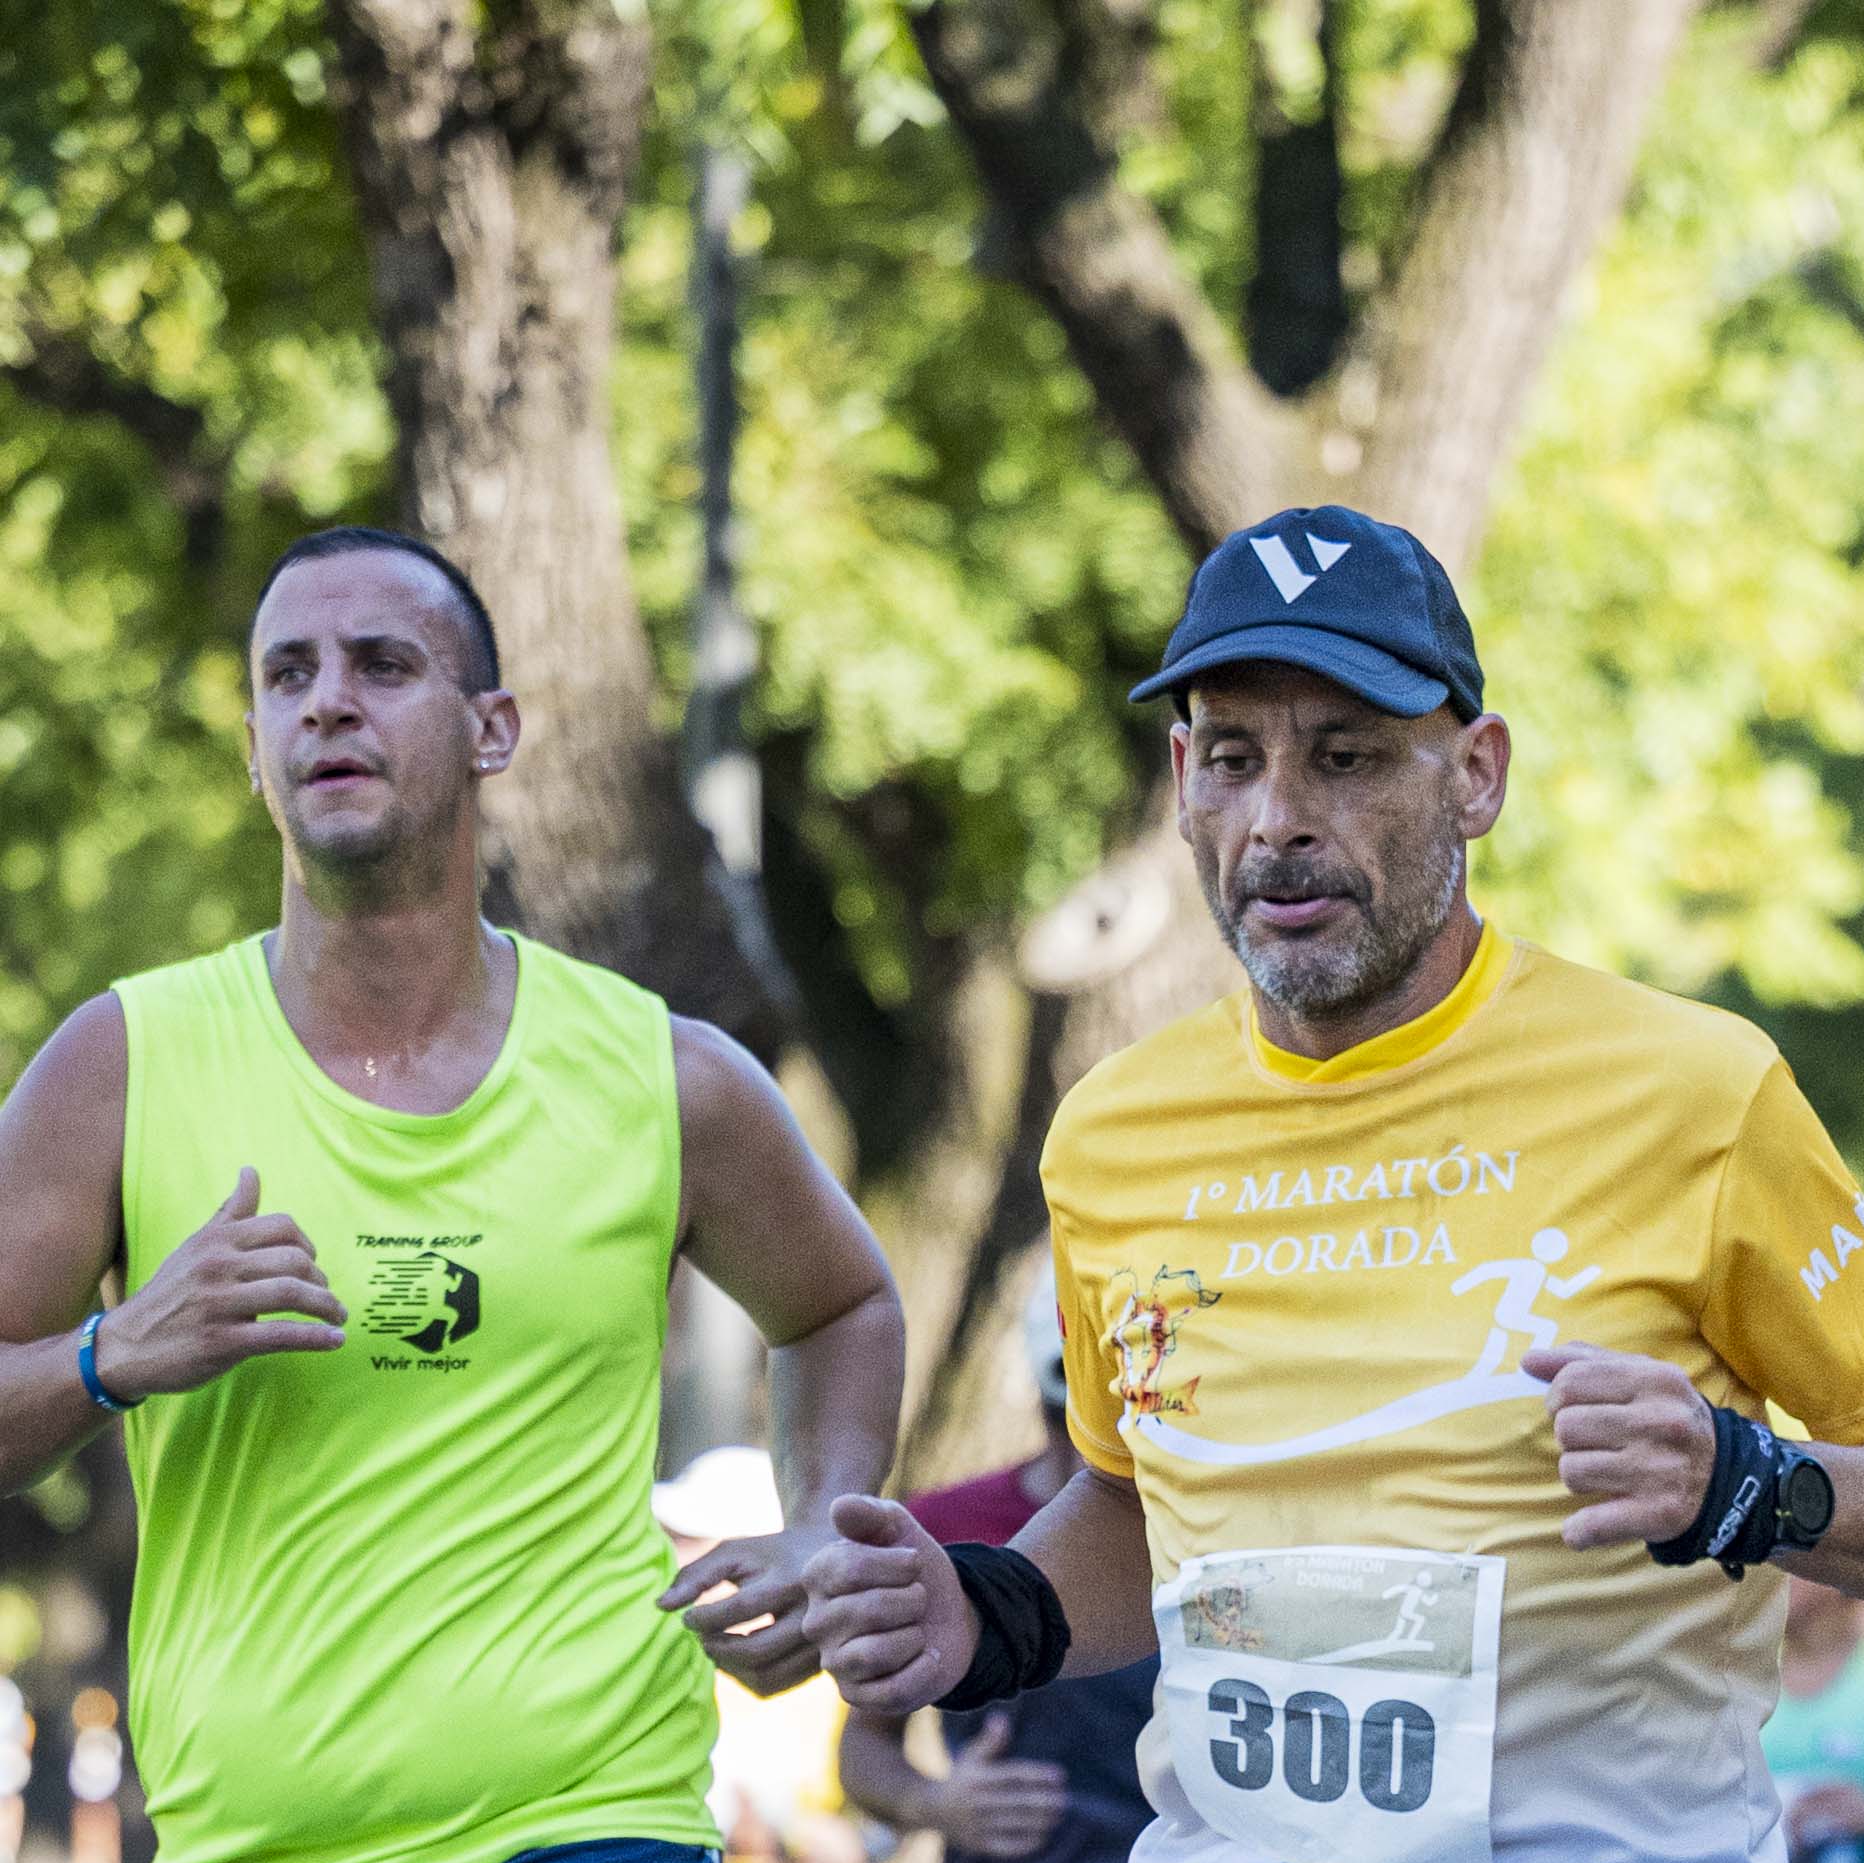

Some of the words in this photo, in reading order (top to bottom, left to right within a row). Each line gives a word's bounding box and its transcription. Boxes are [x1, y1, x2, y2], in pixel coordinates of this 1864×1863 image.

[1232, 1144, 1521, 1215] MARATÓN
[356, 1234, 424, 1248] TRAINING
[429, 1233, 483, 1248] GROUP
[1219, 1222, 1459, 1281] DORADA
[370, 1356, 412, 1371] Vivir
[416, 1356, 471, 1374] mejor
[1208, 1678, 1436, 1813] 300
